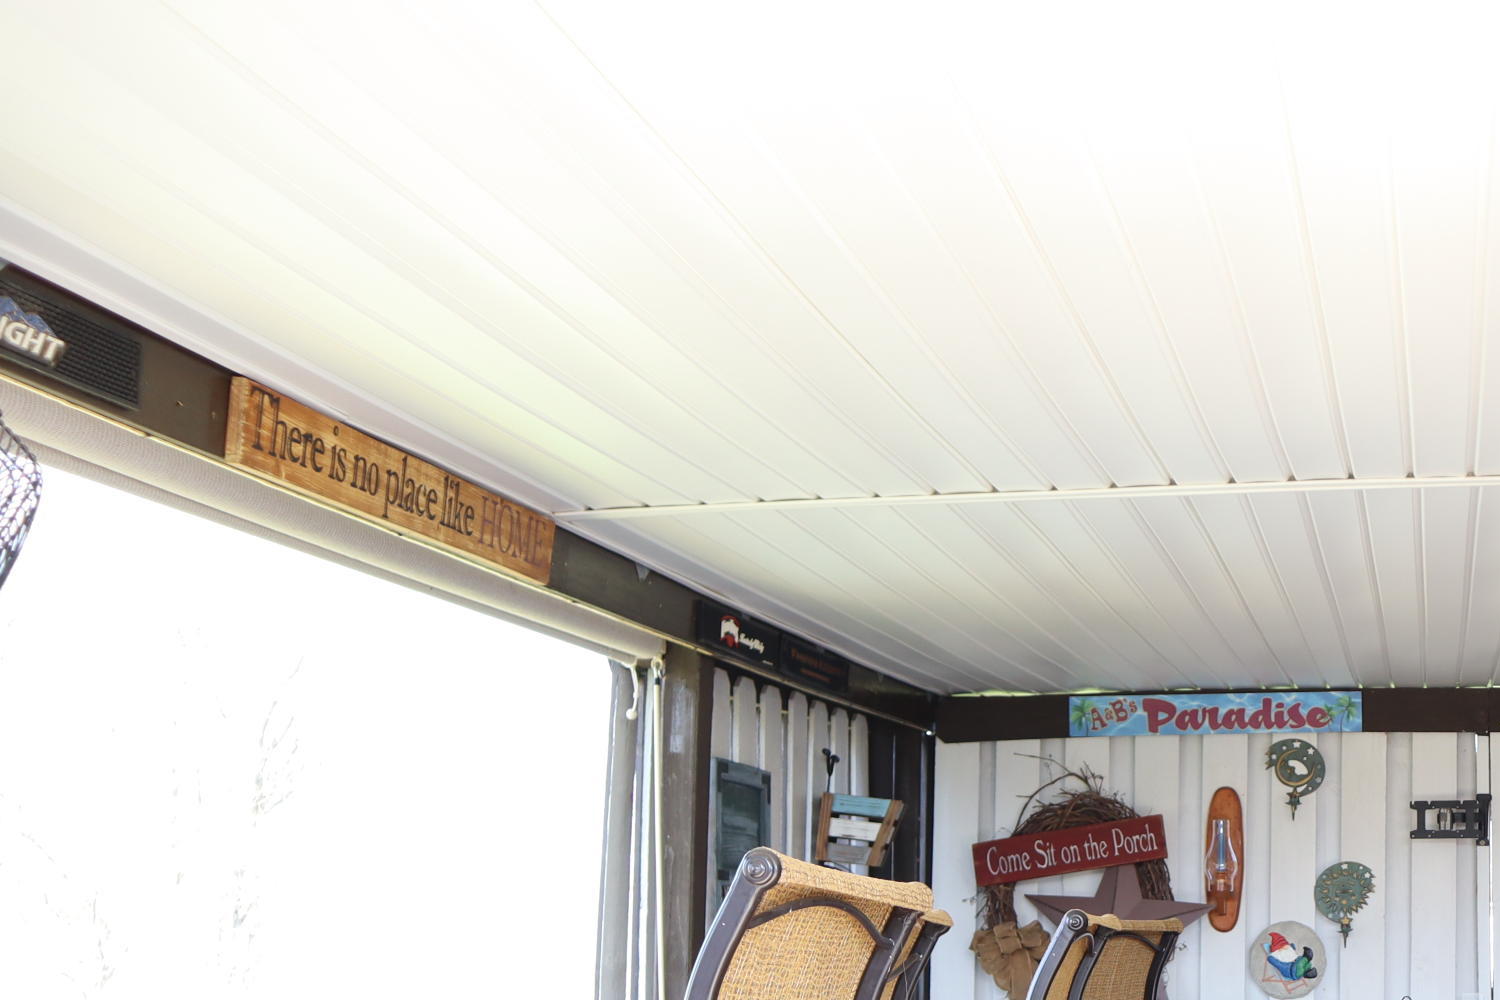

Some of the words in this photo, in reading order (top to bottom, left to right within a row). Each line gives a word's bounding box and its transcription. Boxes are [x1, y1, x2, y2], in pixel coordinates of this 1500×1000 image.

[252, 386, 325, 473] There
[328, 426, 348, 483] is
[350, 454, 380, 497] no
[382, 456, 438, 519] place
[440, 474, 475, 536] like
[478, 495, 548, 568] HOME
[1142, 696, 1331, 734] Paradise
[986, 846, 1031, 876] Come
[1034, 840, 1057, 868] Sit
[1060, 844, 1081, 864] on
[1083, 833, 1109, 859] the
[1112, 824, 1158, 857] Porch
